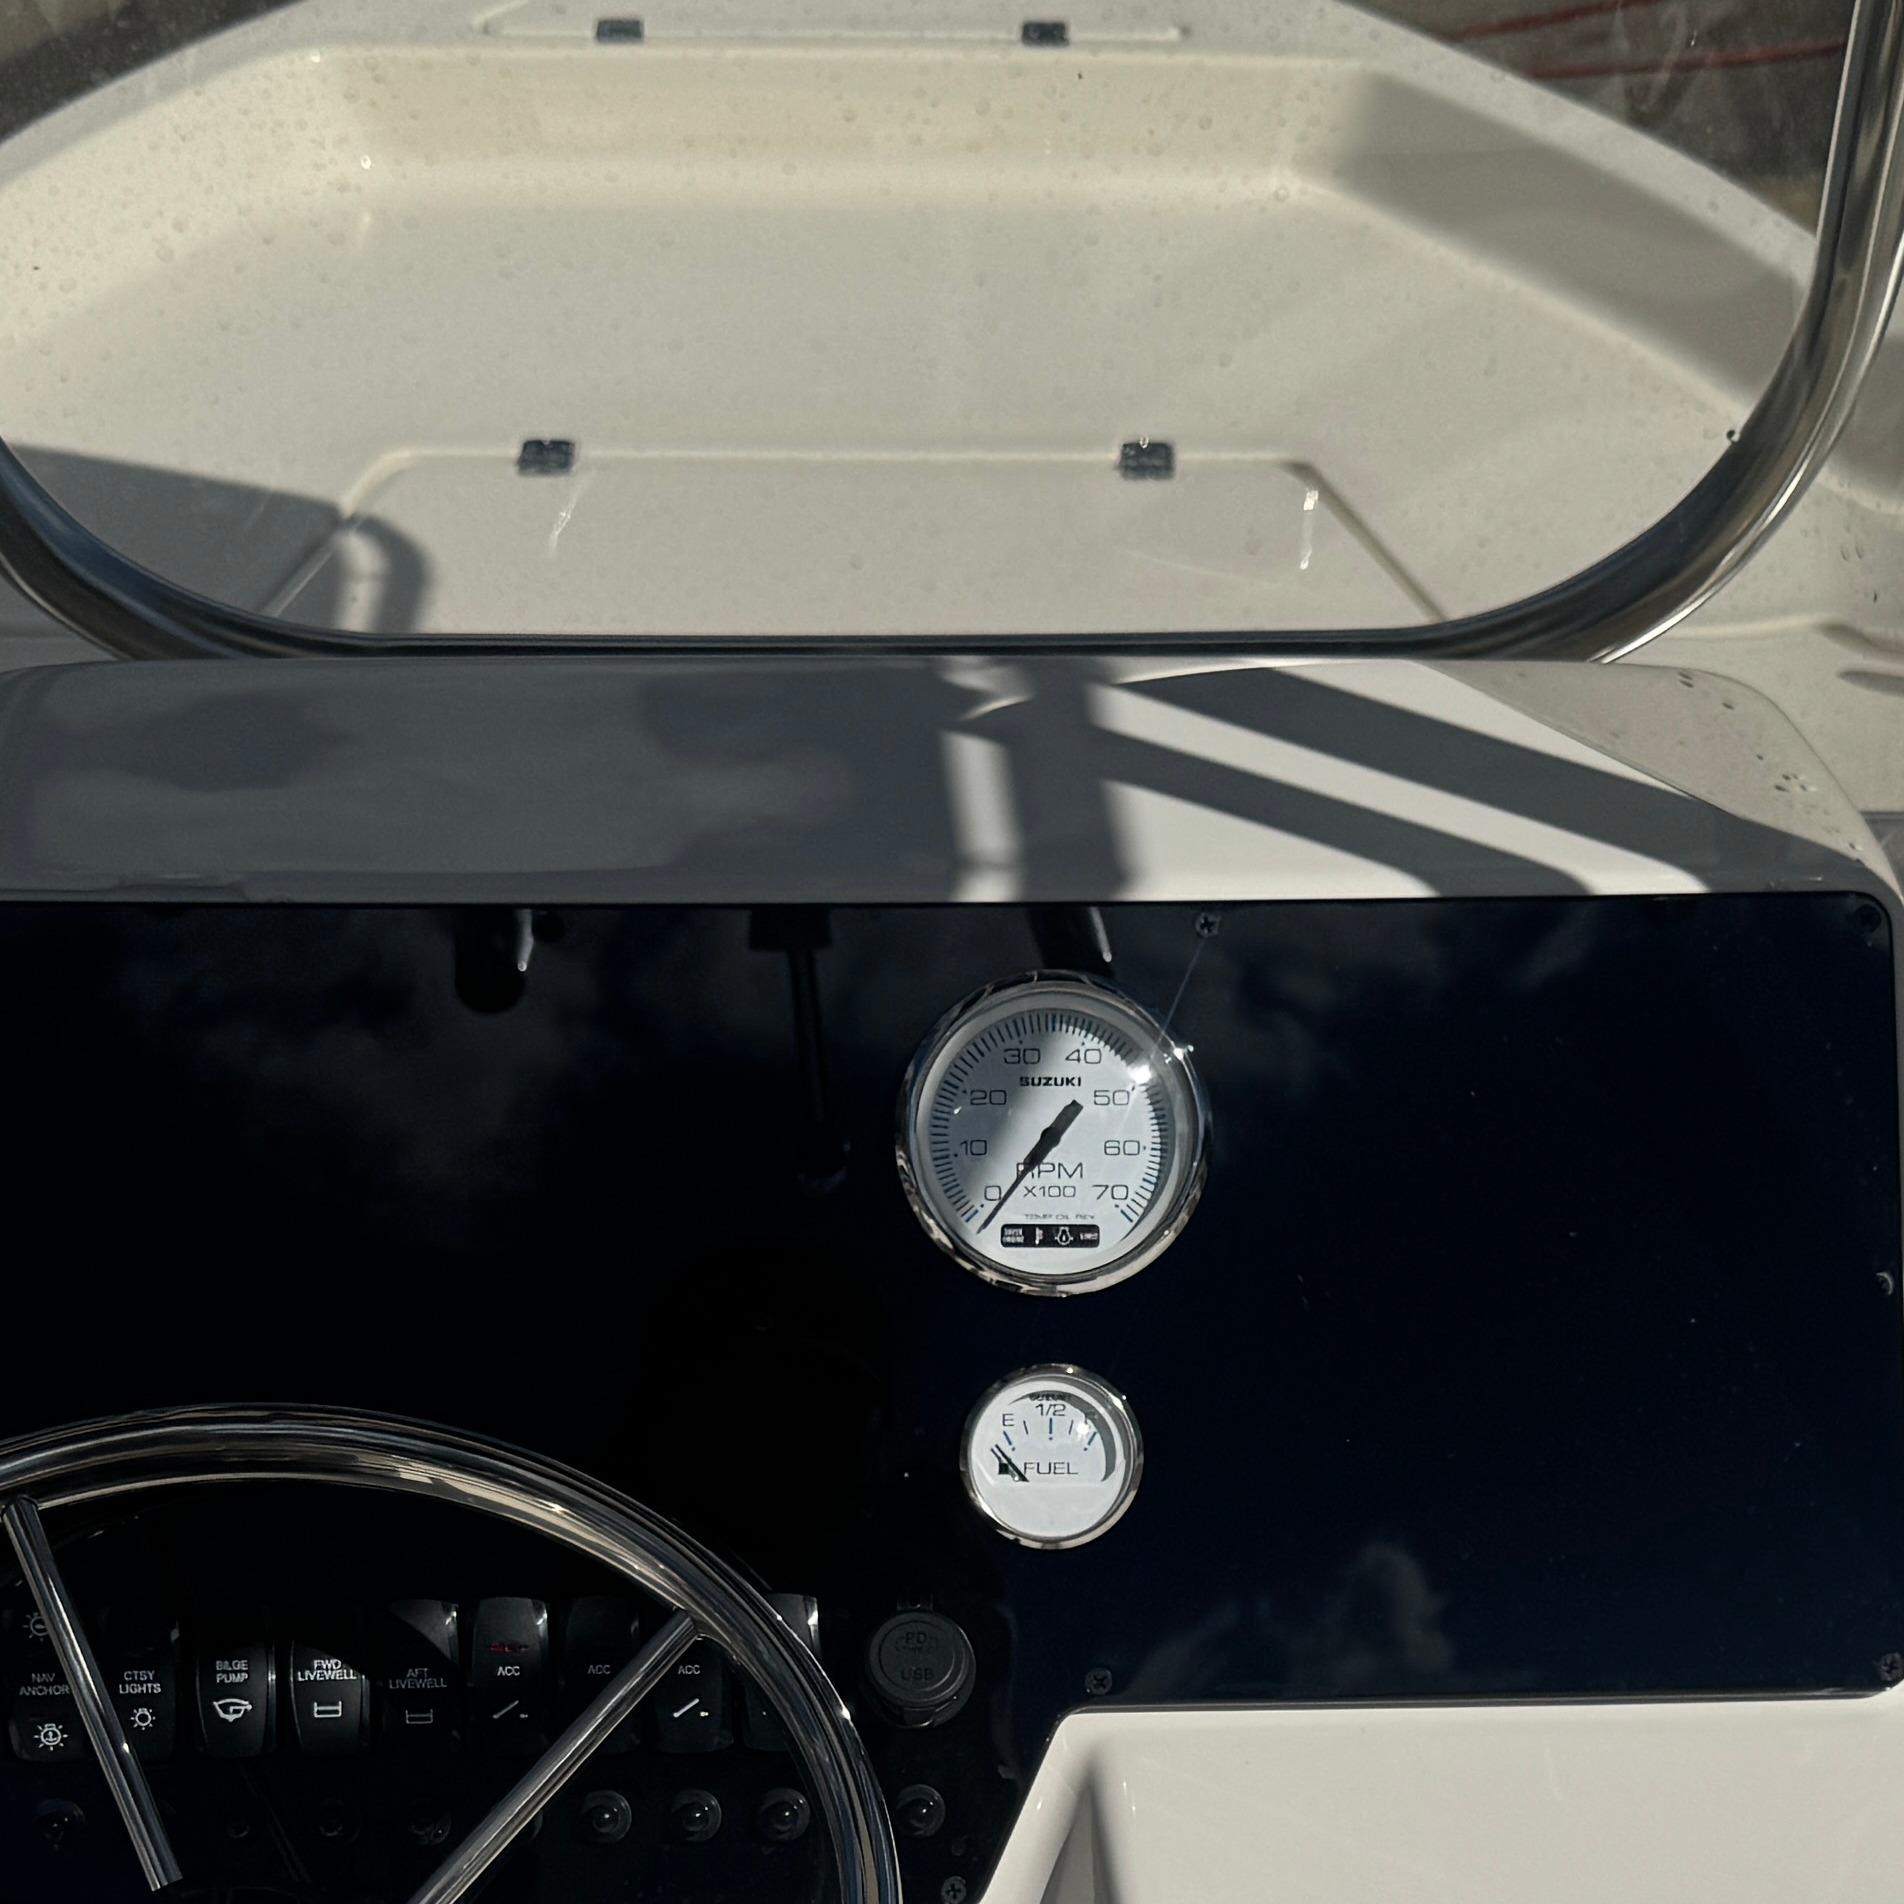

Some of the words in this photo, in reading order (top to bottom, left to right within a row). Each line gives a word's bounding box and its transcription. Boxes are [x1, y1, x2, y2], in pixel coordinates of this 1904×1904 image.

[1003, 1048, 1041, 1064] 30
[1064, 1048, 1102, 1064] 40
[1019, 1076, 1081, 1087] SUZUKI
[970, 1090, 1007, 1106] 20
[1093, 1090, 1130, 1106] 50
[959, 1140, 988, 1156] 10
[1104, 1140, 1140, 1155] 60
[984, 1186, 1002, 1201] 0
[1023, 1185, 1076, 1198] X100
[1092, 1185, 1129, 1200] 70
[1035, 1403, 1066, 1417] 1/2
[1002, 1413, 1014, 1426] E
[1023, 1461, 1079, 1475] FUEL
[215, 1659, 249, 1672] BILGE
[314, 1658, 342, 1672] FWD
[497, 1665, 521, 1678] ACC
[588, 1664, 611, 1677] ACC
[678, 1663, 701, 1676] ACC
[32, 1672, 56, 1684] NAV
[124, 1670, 155, 1683] CTSY
[216, 1671, 249, 1684] PUMP
[298, 1669, 357, 1683] LIVEWELL
[406, 1667, 429, 1679] AFT
[900, 1667, 935, 1681] USB
[119, 1682, 161, 1695] LIGHTS
[389, 1677, 448, 1689] LIVEWELL
[19, 1683, 71, 1697] ANCHOR
